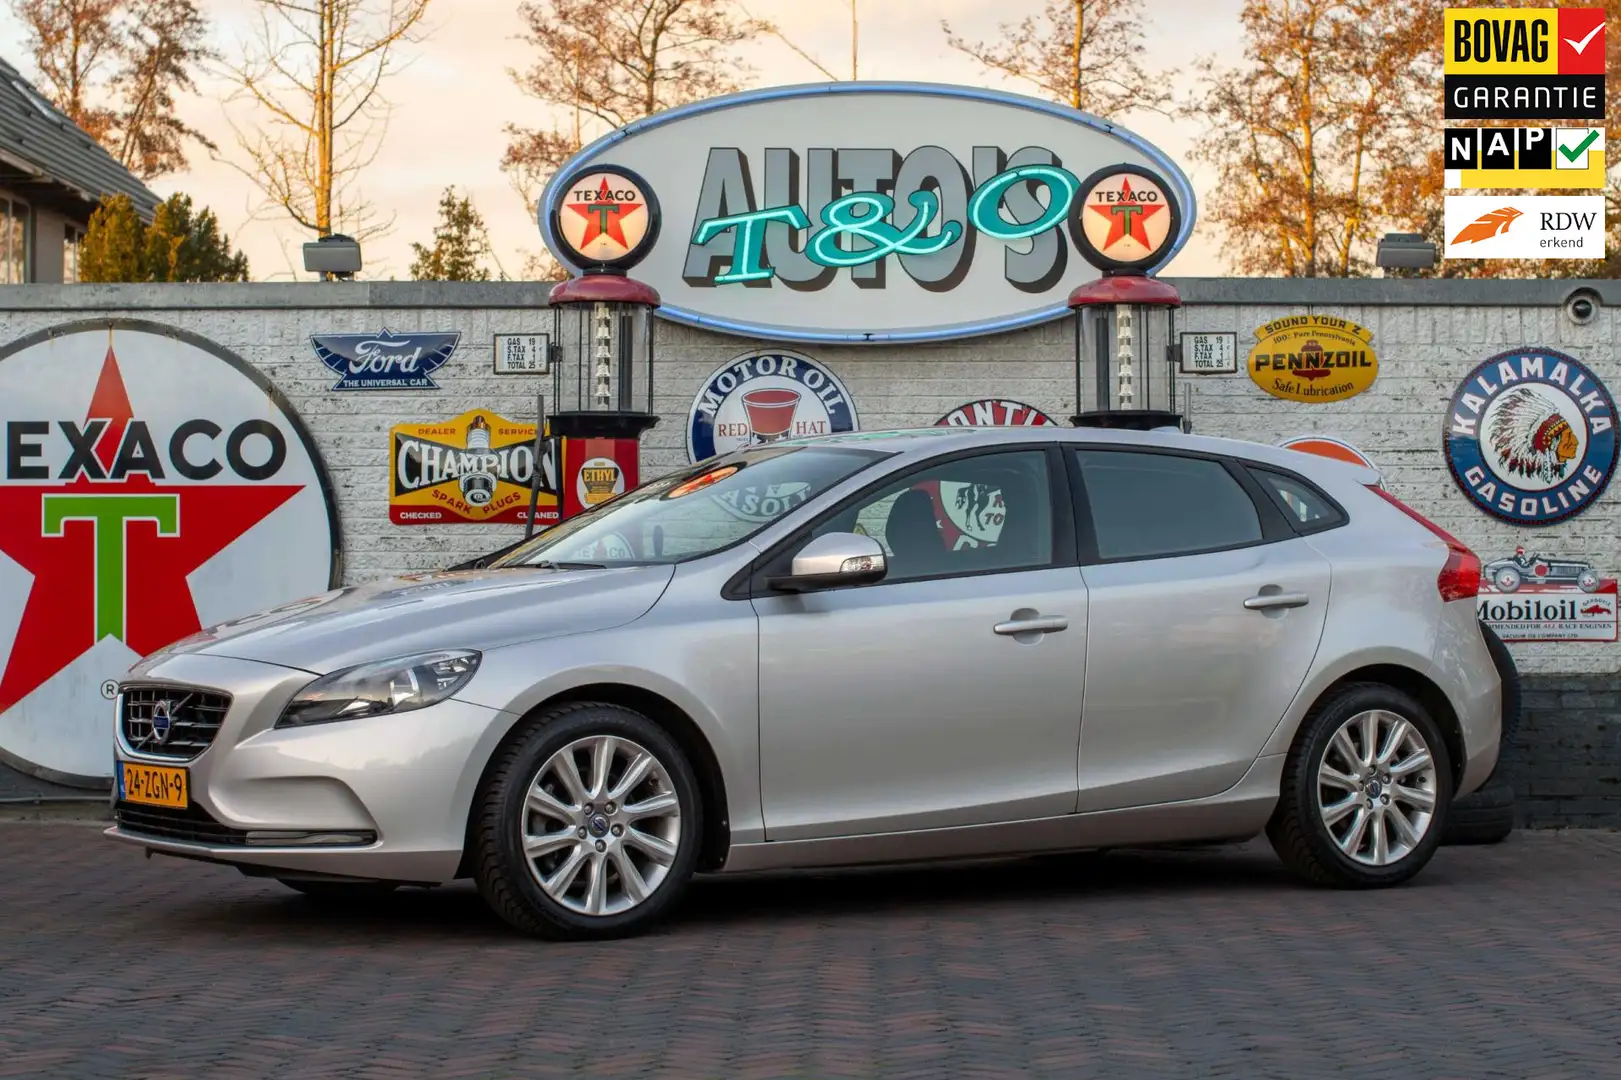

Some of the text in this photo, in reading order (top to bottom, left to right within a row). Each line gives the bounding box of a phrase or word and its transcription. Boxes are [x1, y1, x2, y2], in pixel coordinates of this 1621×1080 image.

[574, 190, 636, 201] TEXACO
[1095, 191, 1158, 202] TEXACO
[683, 145, 1066, 292] AUTO'S
[1265, 316, 1362, 335] SOUND YOUR Z
[1194, 336, 1223, 344] GAS 19
[1194, 344, 1213, 352] S.TAX
[349, 340, 422, 374] Ford
[529, 361, 536, 369] 25
[1195, 360, 1214, 368] TOTAL
[1255, 350, 1372, 372] PENNZOIL
[361, 379, 407, 387] UNIVERSAL
[409, 378, 428, 386] CAR
[698, 356, 844, 417] MOTOR OIL
[1272, 378, 1354, 397] Safe Lubrication
[1452, 357, 1612, 436] KALAMALKA
[718, 421, 826, 437] RED HAT
[7, 419, 287, 481] EXACO
[398, 439, 556, 491] CHAMPION
[583, 469, 616, 481] ETHYL
[1464, 465, 1602, 516] GASOLINE
[432, 489, 521, 514] SPARK PLUGS
[400, 511, 559, 519] CHECKED CLANED
[1477, 600, 1577, 620] Mobiloil
[127, 768, 182, 802] 24-ZGN-9
